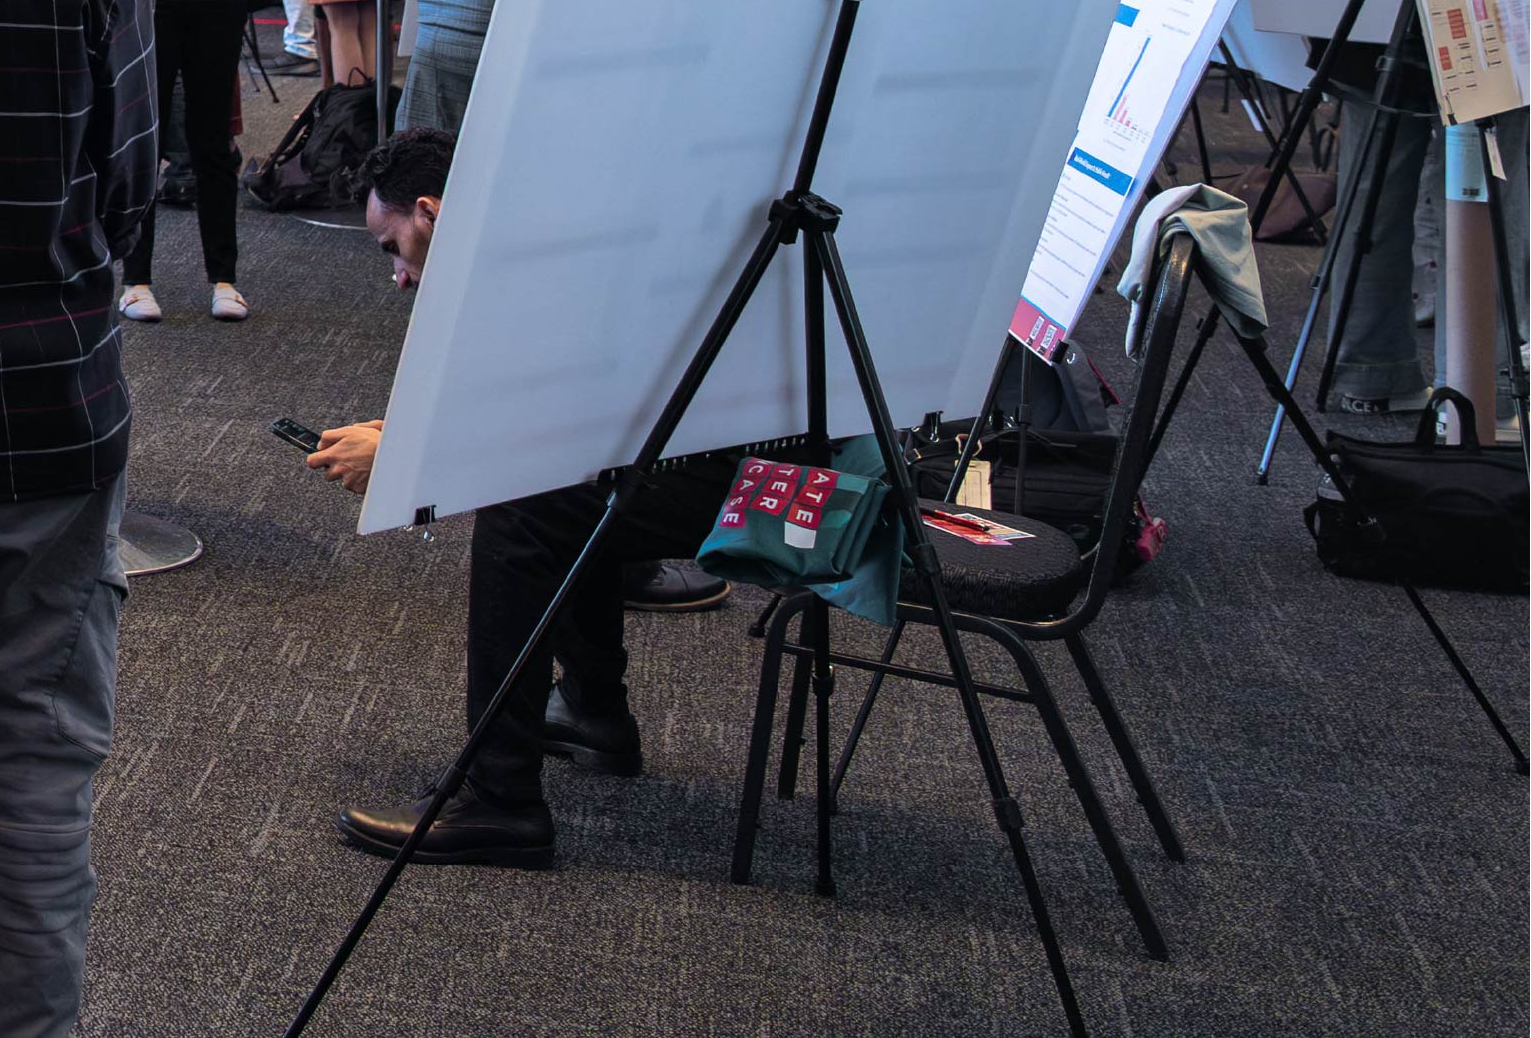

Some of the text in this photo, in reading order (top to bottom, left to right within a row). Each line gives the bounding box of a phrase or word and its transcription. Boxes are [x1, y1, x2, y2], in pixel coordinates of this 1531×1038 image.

[723, 465, 764, 524] CASE
[759, 468, 795, 510] TER
[796, 472, 830, 524] ATE
